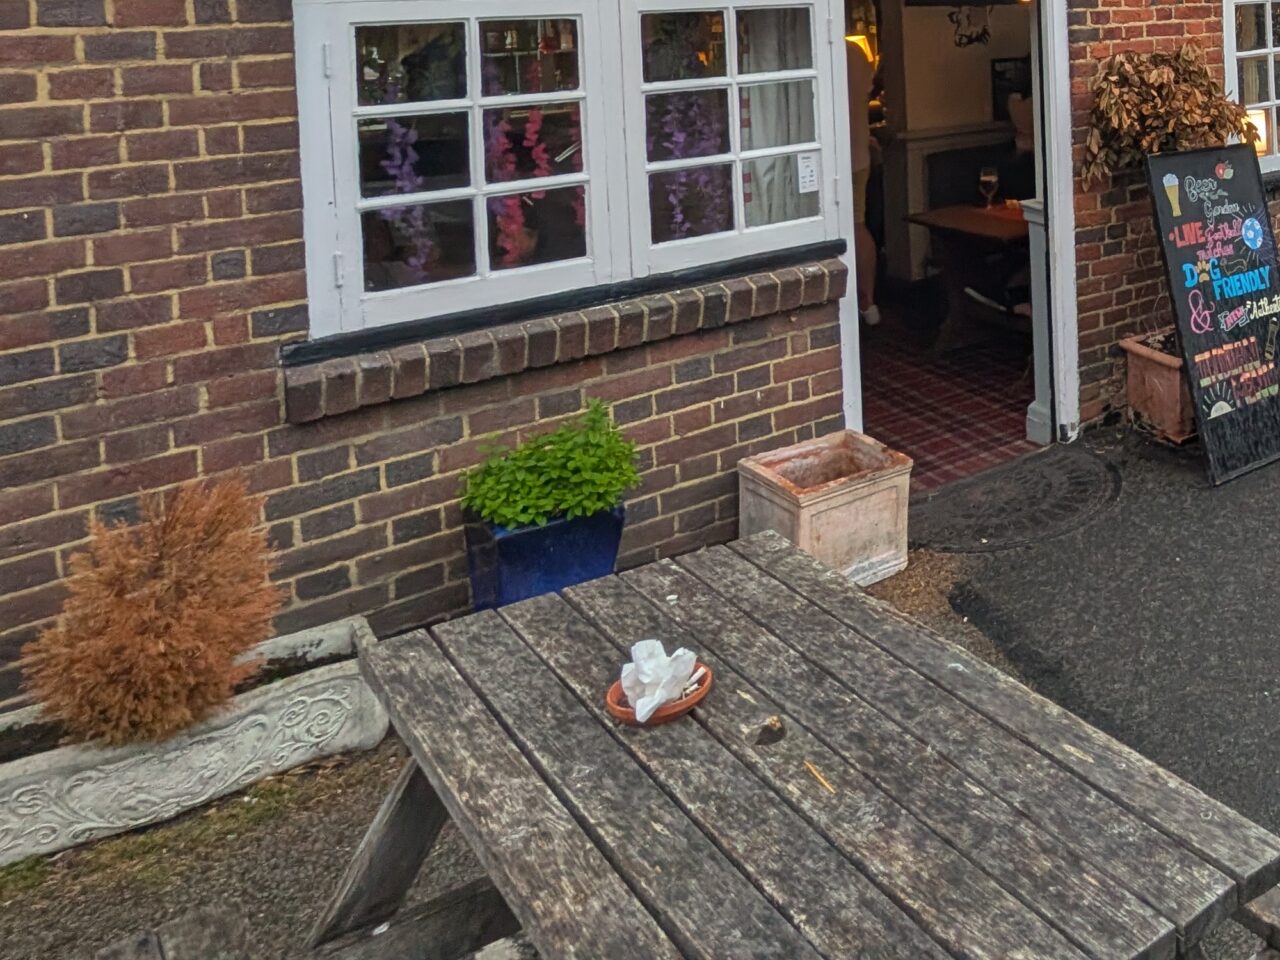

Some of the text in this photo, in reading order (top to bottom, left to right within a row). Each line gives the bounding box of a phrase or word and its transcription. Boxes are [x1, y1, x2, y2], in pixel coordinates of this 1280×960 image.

[1184, 176, 1217, 202] Beer
[1174, 221, 1205, 248] LIVE
[1212, 265, 1270, 300] FRIENDLY
